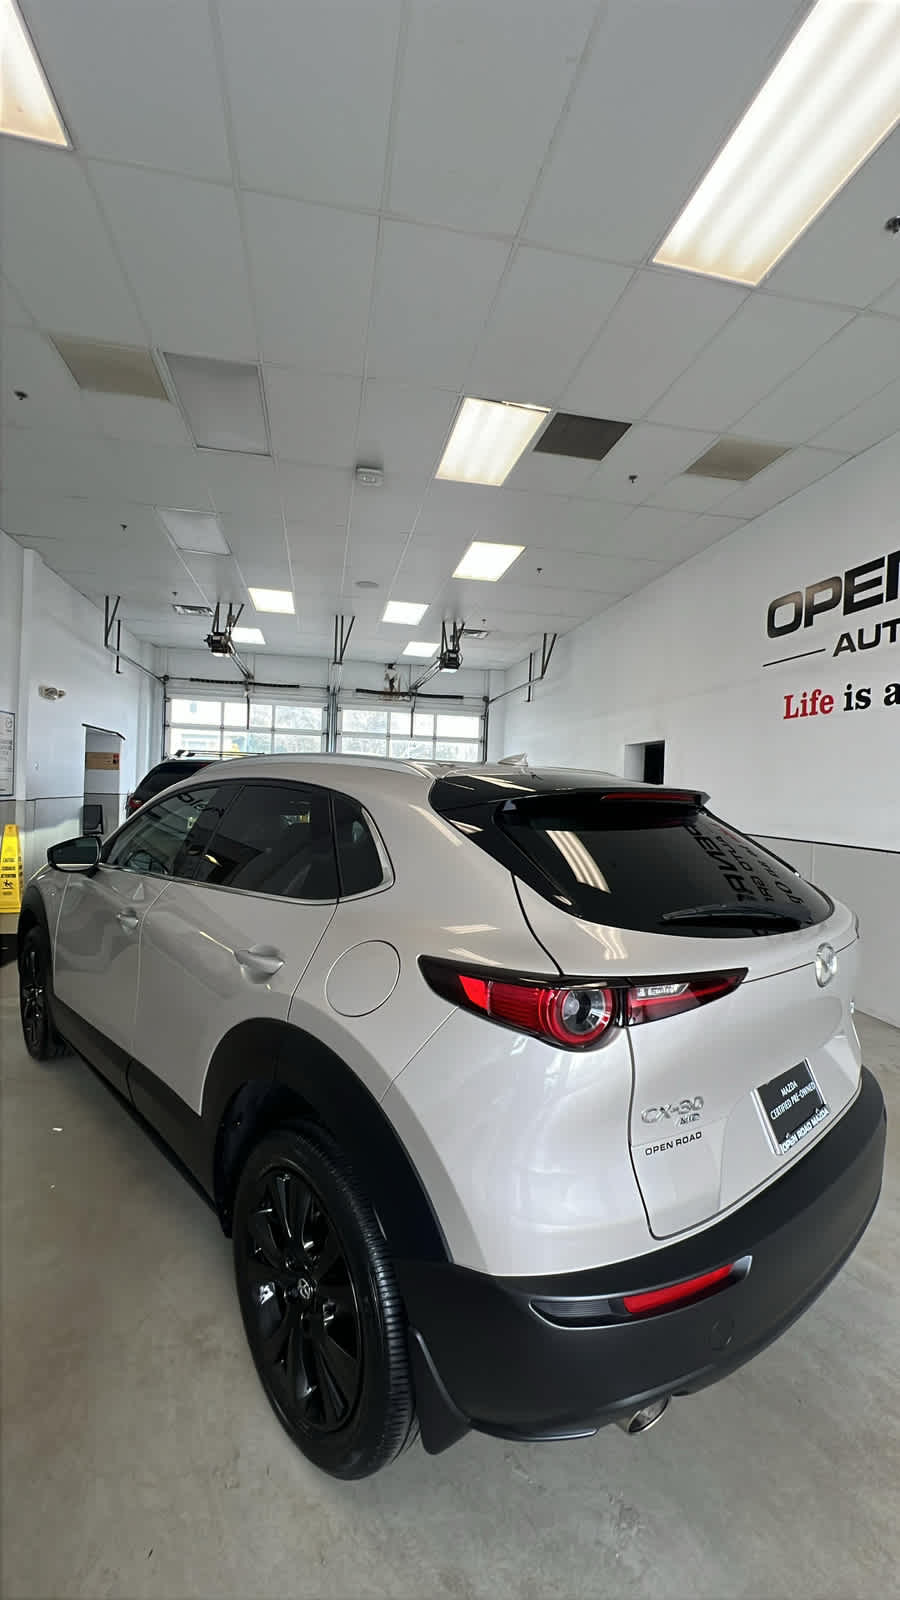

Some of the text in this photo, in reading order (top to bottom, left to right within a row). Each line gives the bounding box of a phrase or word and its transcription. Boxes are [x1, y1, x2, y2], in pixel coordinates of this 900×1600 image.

[783, 688, 834, 720] Life
[843, 683, 871, 712] is
[769, 1081, 816, 1120] CERTIFIED PRE-OWNED
[780, 1081, 798, 1097] MAZDA
[641, 1096, 704, 1123] CX-30
[645, 1131, 702, 1156] OPEN ROAD
[782, 1108, 829, 1154] OPEN ROAD MAZDA
